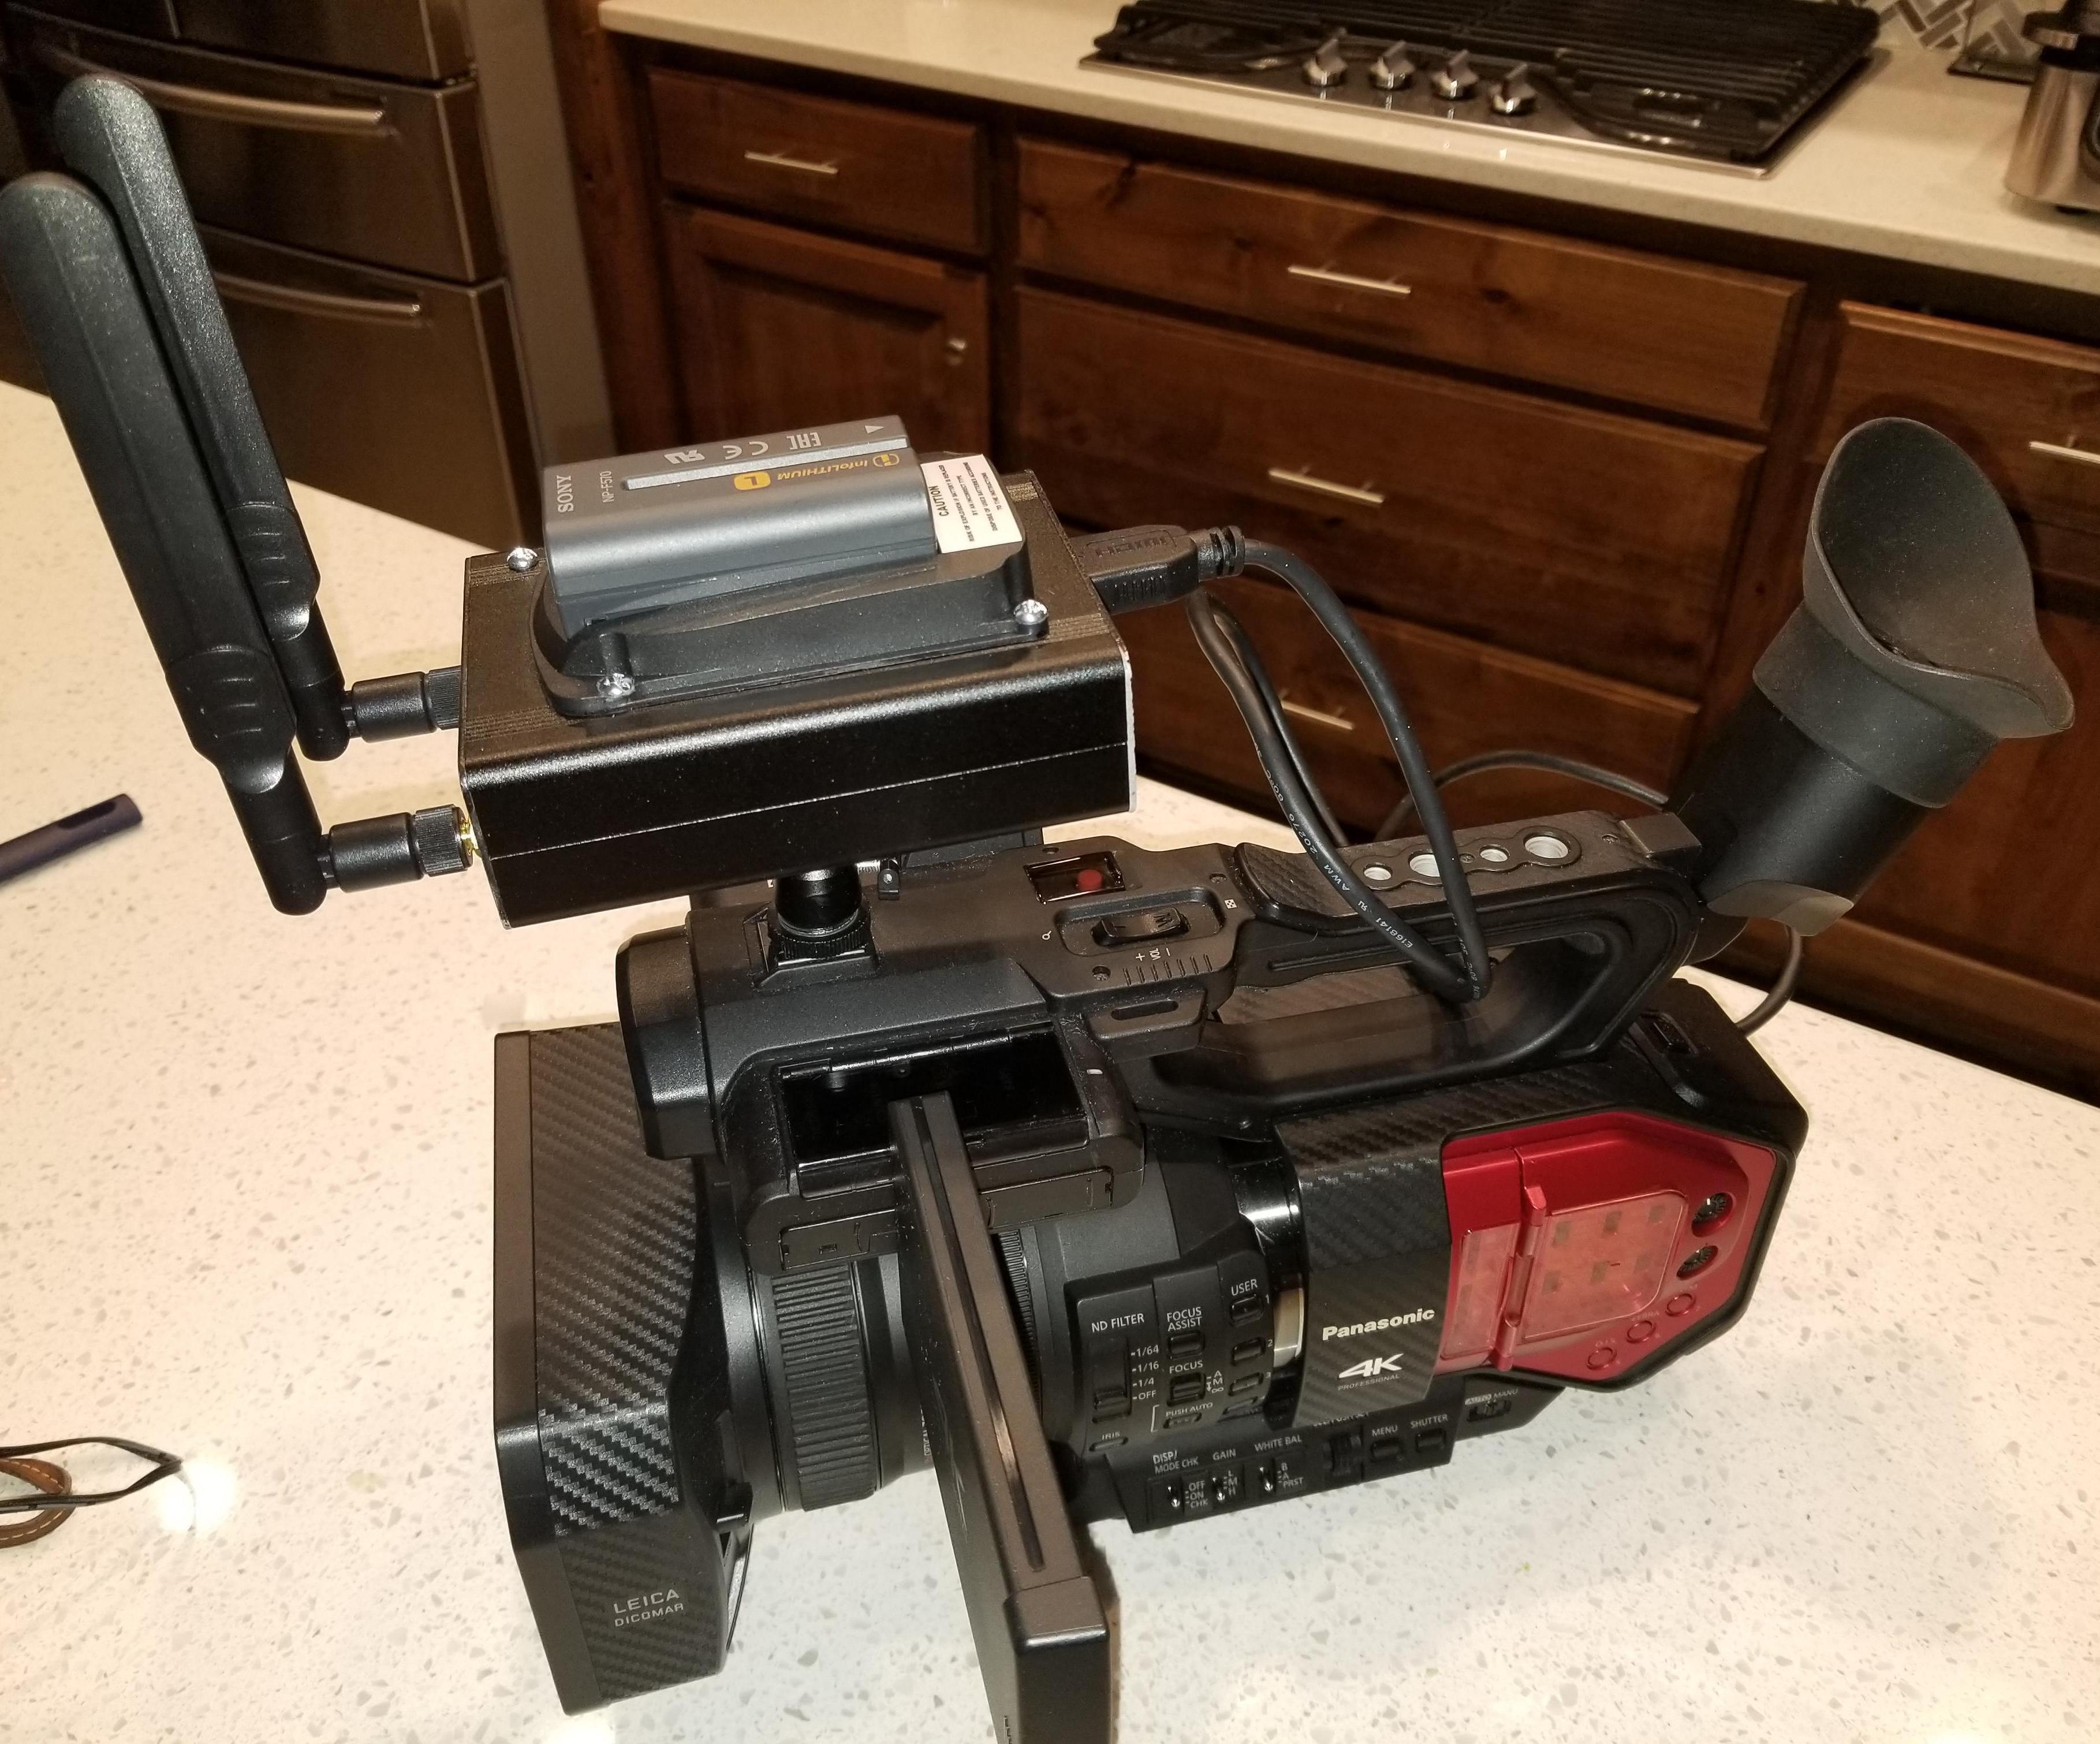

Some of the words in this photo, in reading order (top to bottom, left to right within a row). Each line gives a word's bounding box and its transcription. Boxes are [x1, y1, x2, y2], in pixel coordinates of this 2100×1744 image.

[556, 475, 574, 513] SONY
[599, 471, 614, 503] NP-F570
[928, 485, 949, 517] CAUTION
[1289, 813, 1318, 854] 20276
[1323, 864, 1351, 891] AWM
[1375, 917, 1413, 948] E168141
[1230, 1279, 1258, 1296] USER
[1265, 1294, 1270, 1303] 1
[1166, 1306, 1202, 1322] FOCUS
[1091, 1321, 1108, 1333] ND
[1111, 1313, 1145, 1329] FILTER
[1168, 1316, 1202, 1332] ASSIST
[1322, 1308, 1435, 1341] Panasonic
[1169, 1360, 1203, 1374] FOCUS
[1338, 1353, 1404, 1378] 4K
[1338, 1374, 1400, 1391] PROFESSIONAL
[1138, 1389, 1157, 1400] OFF
[1165, 1408, 1188, 1417] PUSH
[1189, 1402, 1214, 1413] AUTO
[1409, 1414, 1449, 1429] SHUTTER
[1102, 1431, 1121, 1440] IRIS
[1371, 1425, 1398, 1437] MENU
[1254, 1437, 1283, 1452] WHITE
[1285, 1434, 1303, 1445] BAL
[1213, 1448, 1237, 1460] GAIN
[1155, 1460, 1180, 1474] MODE
[1181, 1456, 1199, 1467] CHK
[1189, 1480, 1206, 1492] OFF
[1190, 1491, 1204, 1500] ON
[614, 1589, 680, 1613] LEICA
[614, 1603, 684, 1627] DICOMAR
